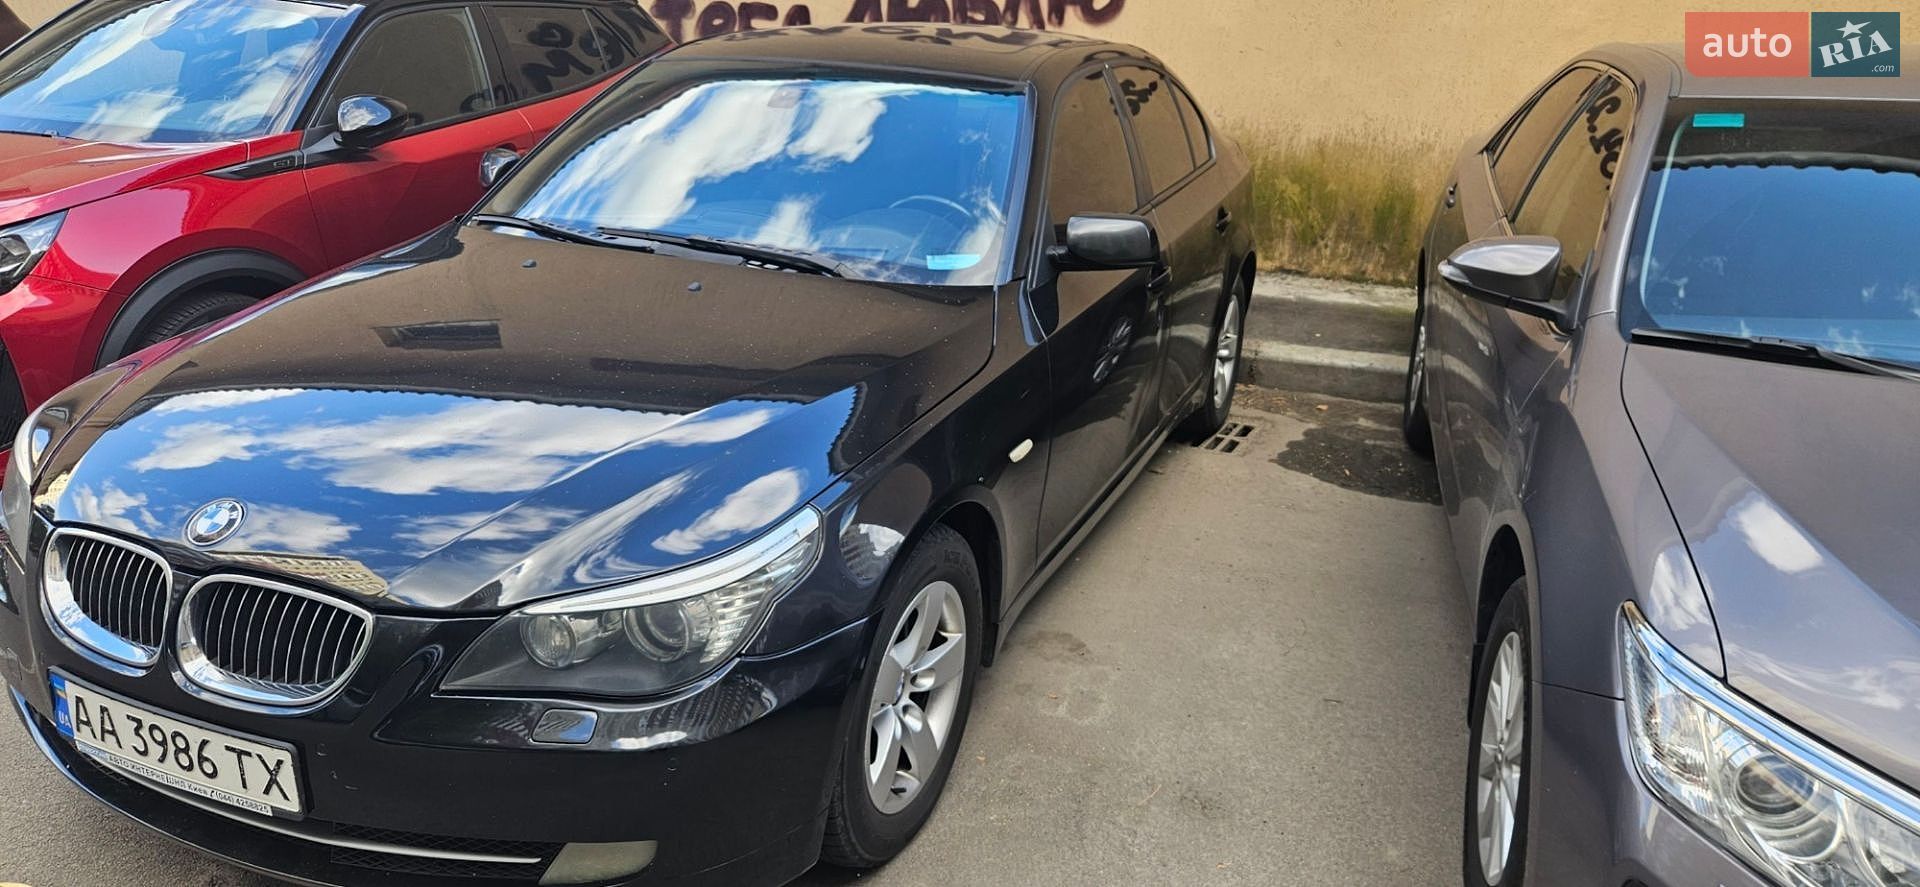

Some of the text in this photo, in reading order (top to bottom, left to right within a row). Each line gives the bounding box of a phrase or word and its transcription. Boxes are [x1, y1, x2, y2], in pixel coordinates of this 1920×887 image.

[58, 710, 71, 728] UA
[75, 695, 290, 801] AA 3986 TX
